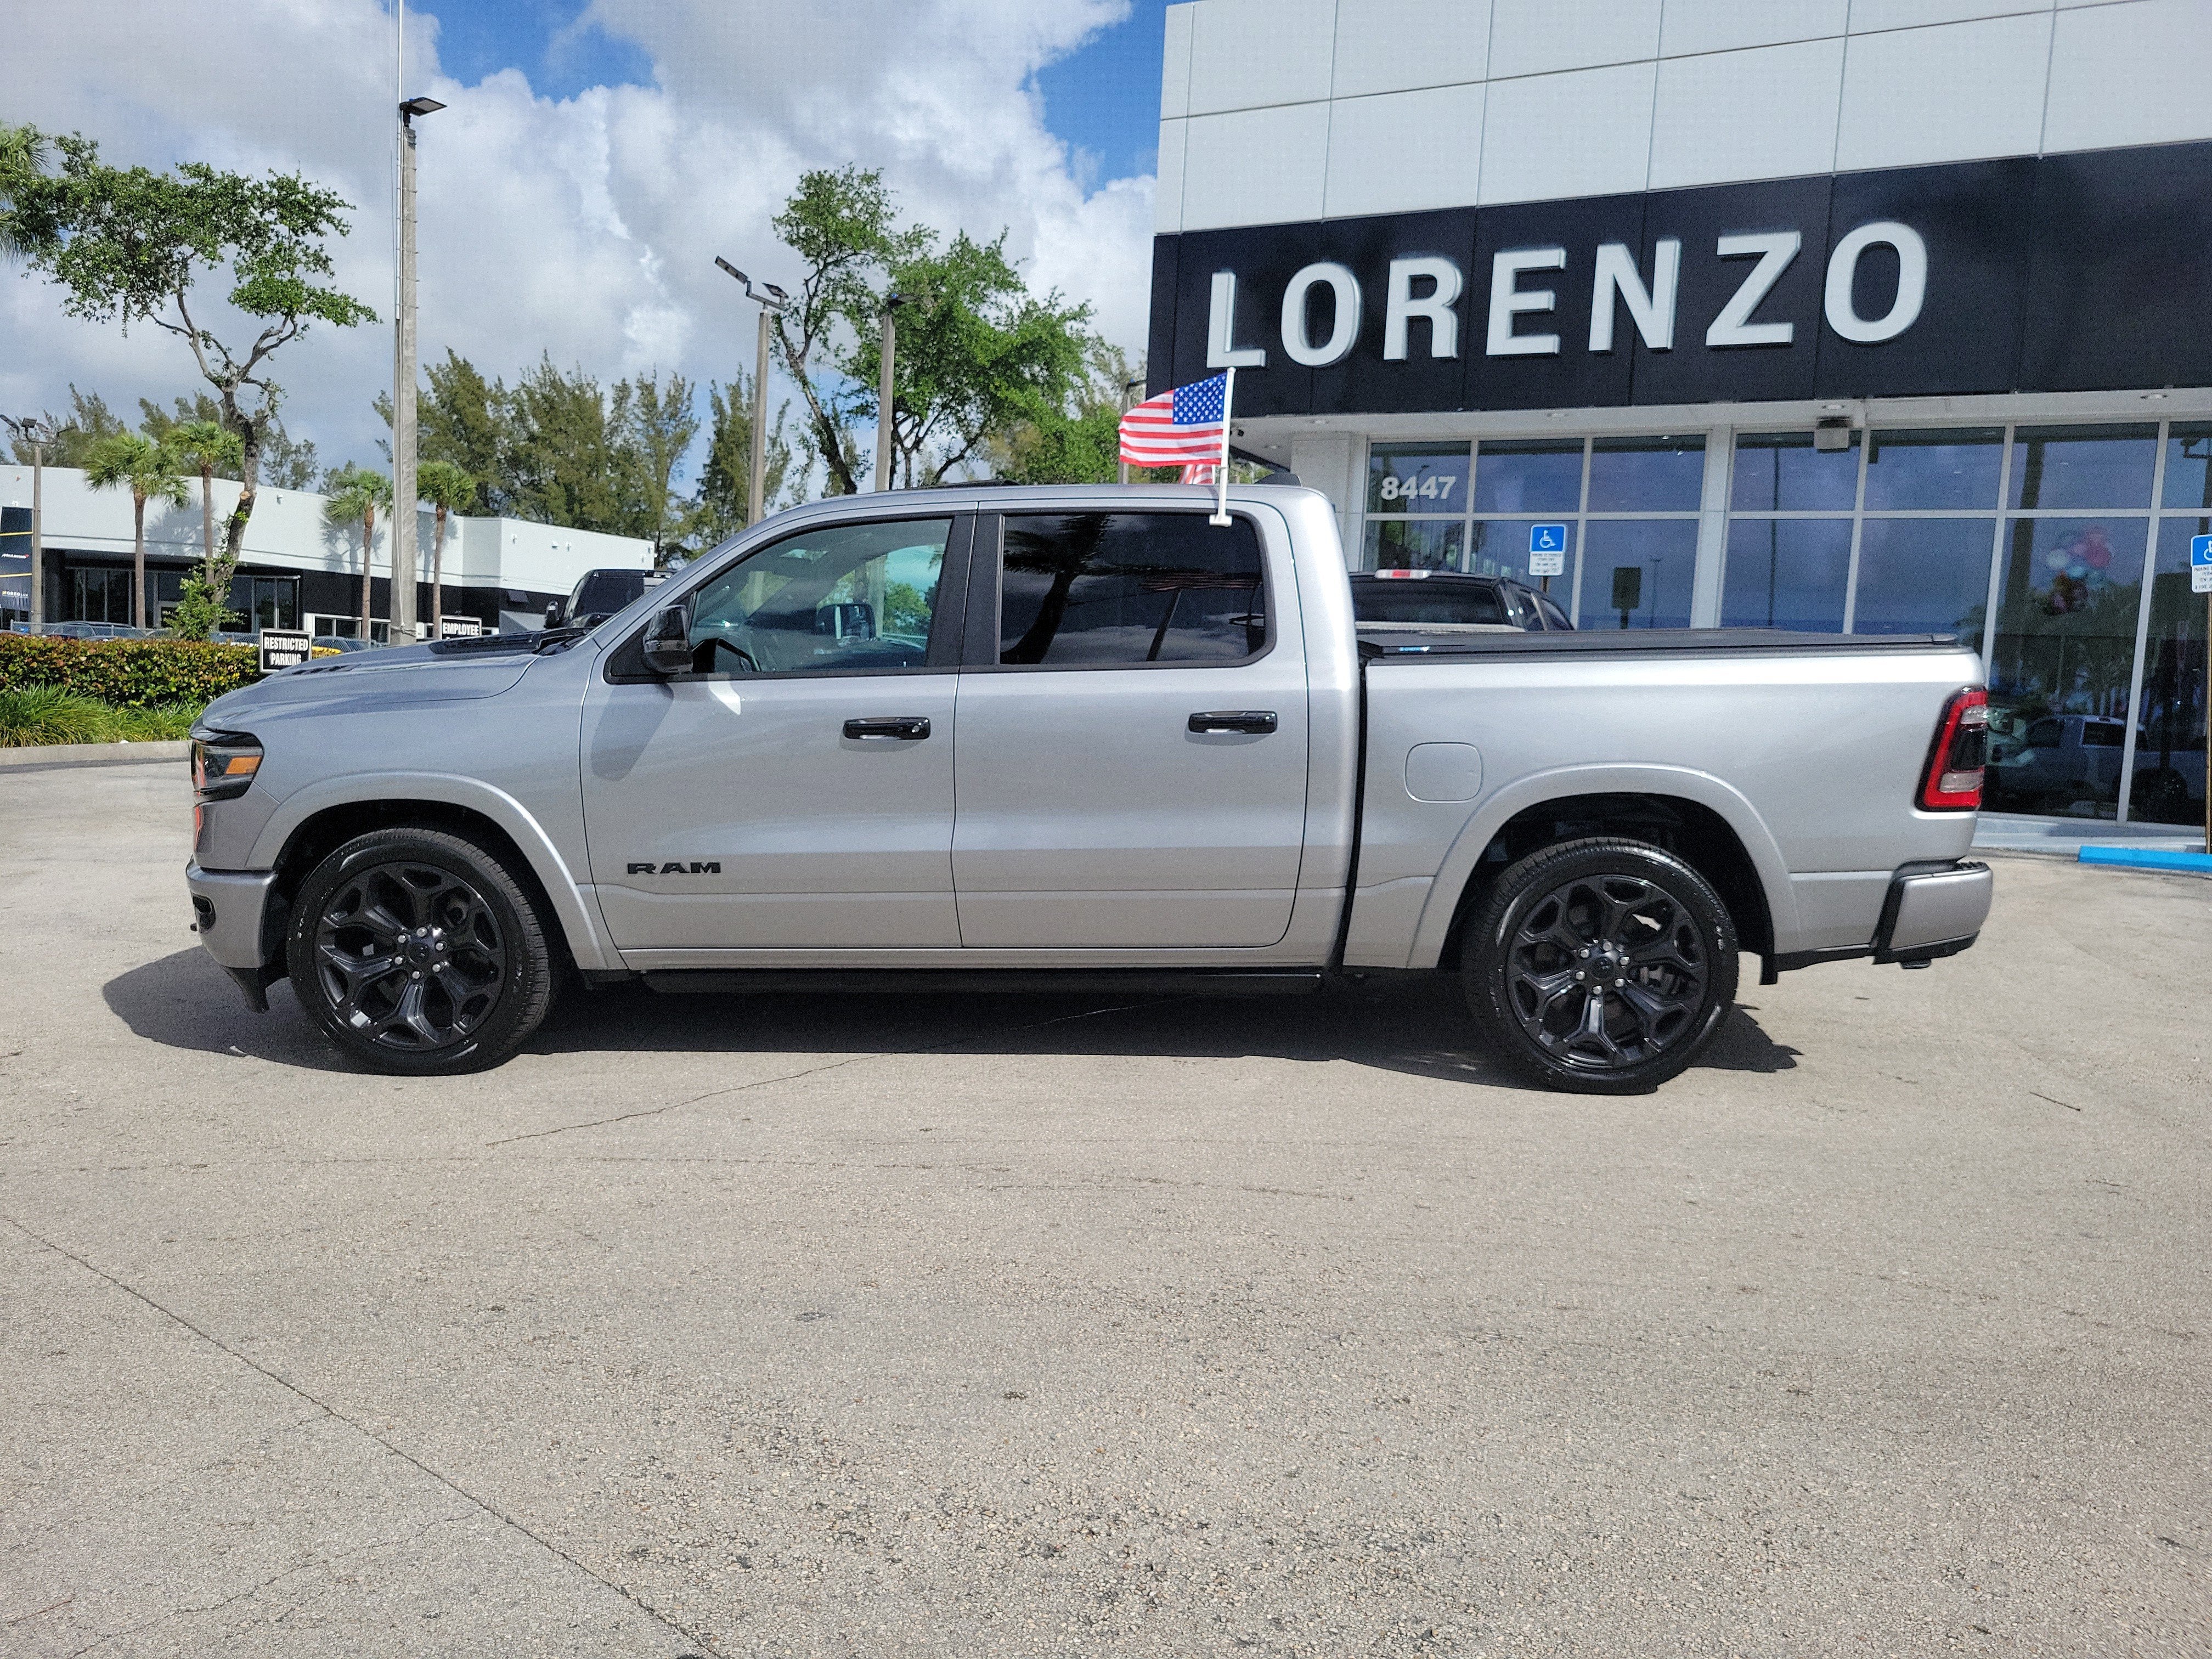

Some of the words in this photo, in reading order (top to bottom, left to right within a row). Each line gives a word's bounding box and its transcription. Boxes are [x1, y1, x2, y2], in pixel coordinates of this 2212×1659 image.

[1206, 221, 1927, 368] LORENZO
[1381, 476, 1457, 500] 8447
[442, 622, 480, 636] EMPLOYEE
[264, 636, 308, 651] RESTRICTED
[270, 652, 302, 665] PARKING
[627, 862, 721, 874] RAM
